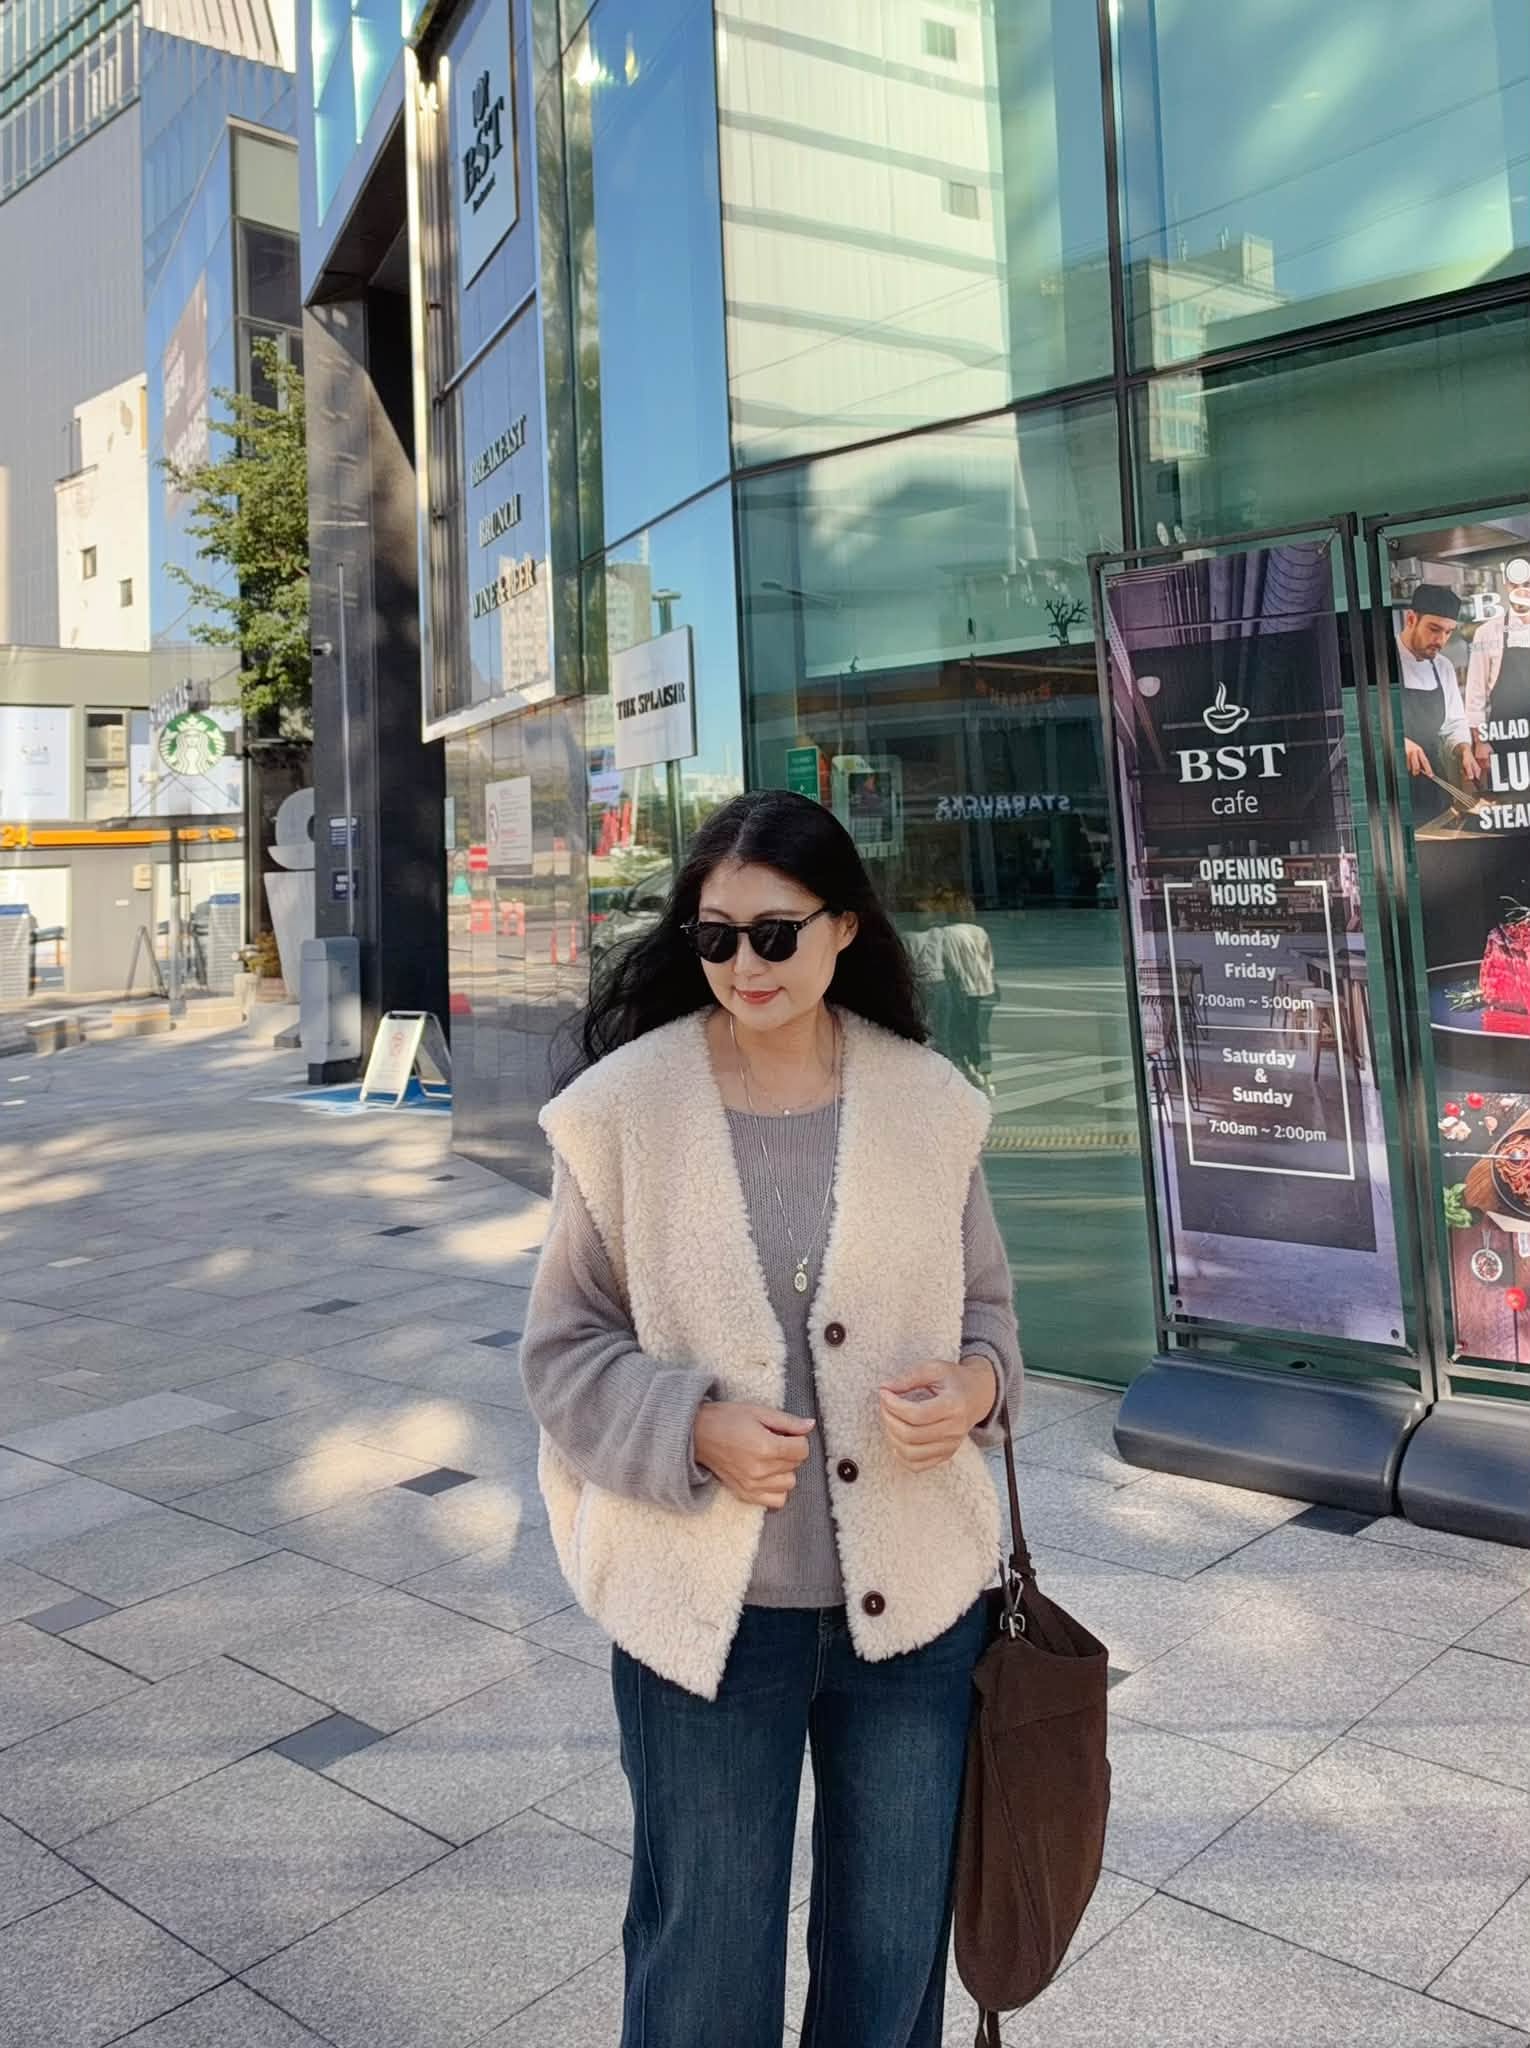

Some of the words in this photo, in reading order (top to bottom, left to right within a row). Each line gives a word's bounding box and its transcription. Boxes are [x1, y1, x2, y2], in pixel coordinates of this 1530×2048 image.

[463, 96, 504, 204] BST
[1176, 743, 1286, 783] BST
[1211, 789, 1258, 815] cafe
[1199, 857, 1284, 881] OPENING
[1211, 883, 1278, 906] HOURS
[1214, 930, 1281, 949] Monday
[1224, 962, 1276, 981] Friday
[1197, 994, 1245, 1008] 7:00am
[1261, 995, 1314, 1012] 5:00pm
[1222, 1047, 1297, 1069] Saturday
[1254, 1067, 1268, 1083] &
[1232, 1086, 1293, 1108] Sunday
[1208, 1119, 1257, 1136] 7:00am
[1273, 1124, 1327, 1142] 2:00pm
